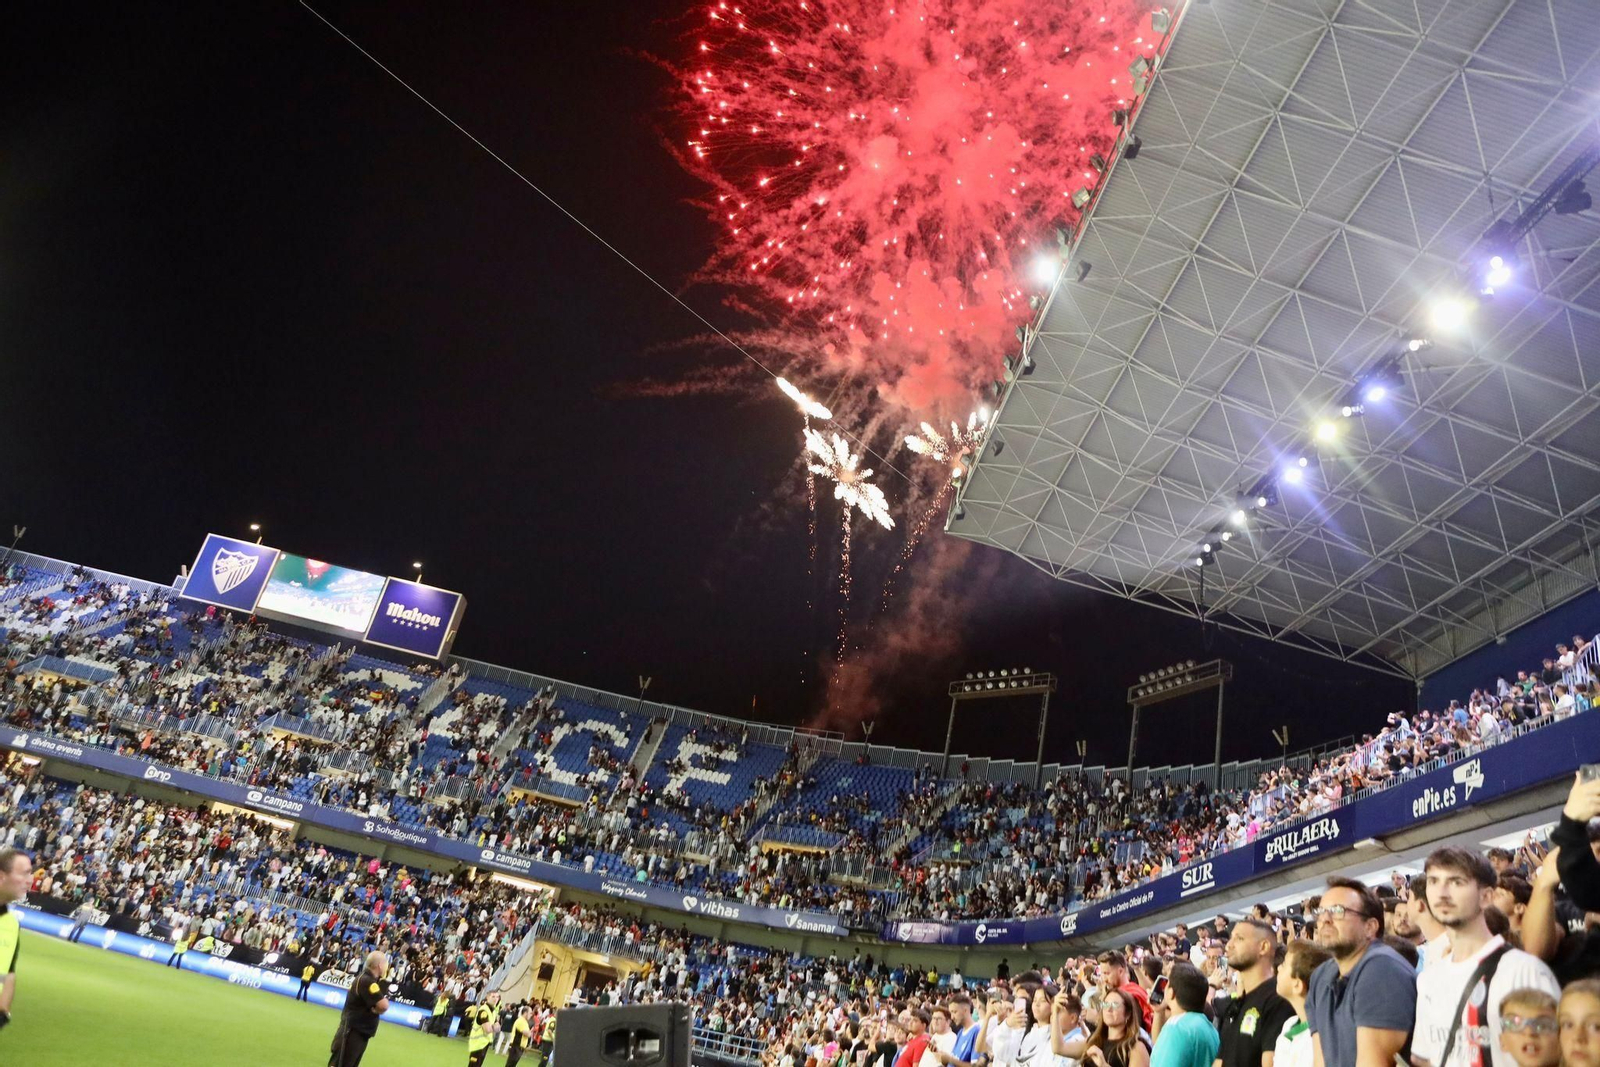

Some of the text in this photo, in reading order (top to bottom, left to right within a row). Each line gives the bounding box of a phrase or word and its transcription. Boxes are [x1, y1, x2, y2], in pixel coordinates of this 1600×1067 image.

[386, 602, 441, 627] Mahou
[31, 737, 56, 750] divina
[56, 744, 83, 757] events
[263, 795, 304, 812] campano
[1413, 786, 1456, 818] enPie.es
[375, 824, 428, 844] SohoBoutique
[496, 854, 532, 869] campano
[1182, 862, 1214, 889] SUR
[700, 901, 740, 918] vithas
[1116, 902, 1129, 913] Centro
[1129, 894, 1142, 908] Oficial
[1142, 893, 1148, 903] de
[1147, 890, 1154, 901] FP
[796, 919, 836, 934] Sanamar
